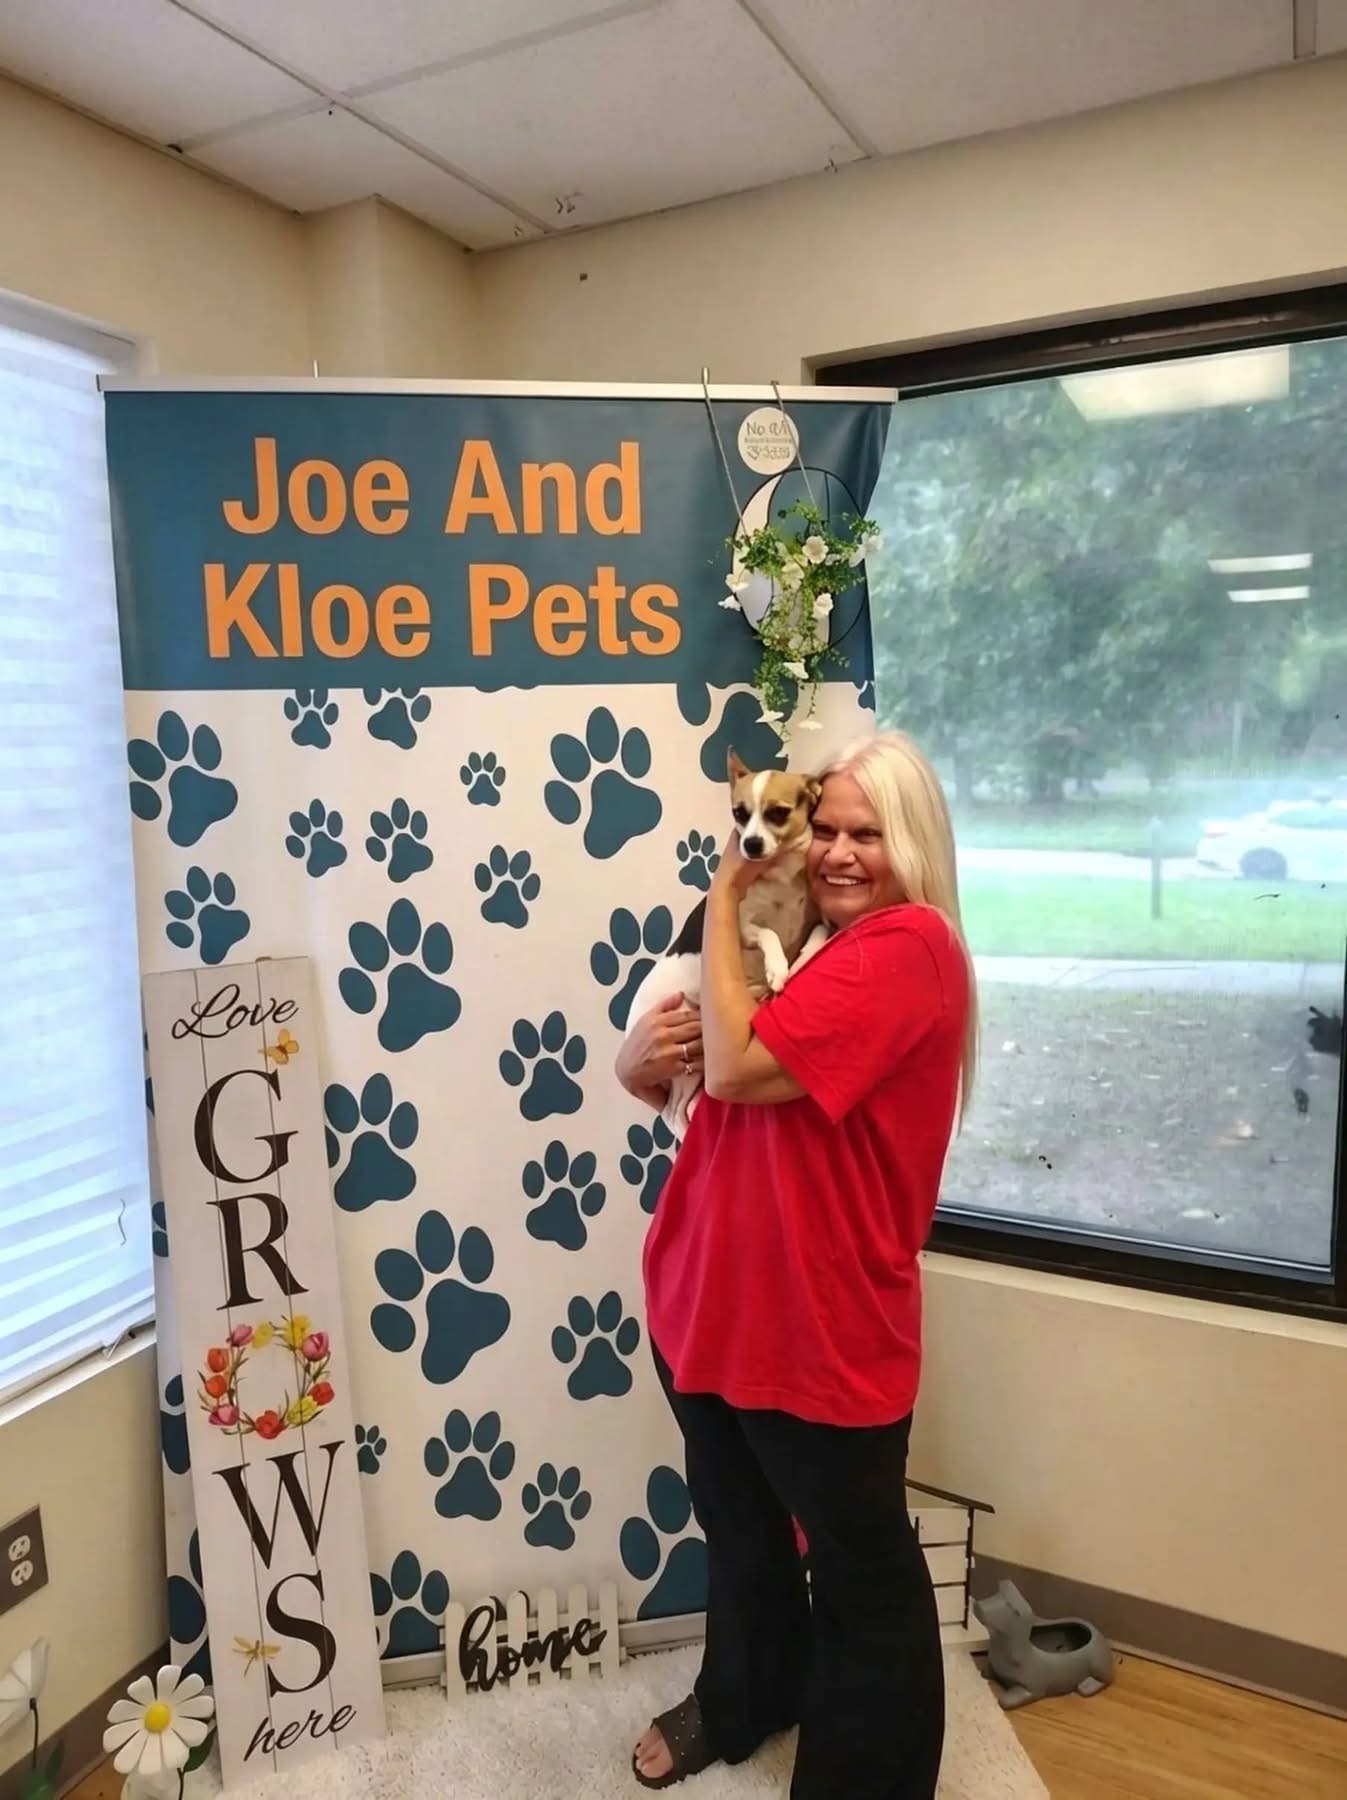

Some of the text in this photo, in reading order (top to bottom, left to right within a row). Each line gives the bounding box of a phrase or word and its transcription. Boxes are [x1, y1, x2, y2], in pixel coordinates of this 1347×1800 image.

[222, 436, 642, 536] Joe And
[203, 562, 682, 659] Kloe Pets
[171, 983, 299, 1040] Love
[458, 1604, 608, 1692] home
[243, 1703, 357, 1762] here
